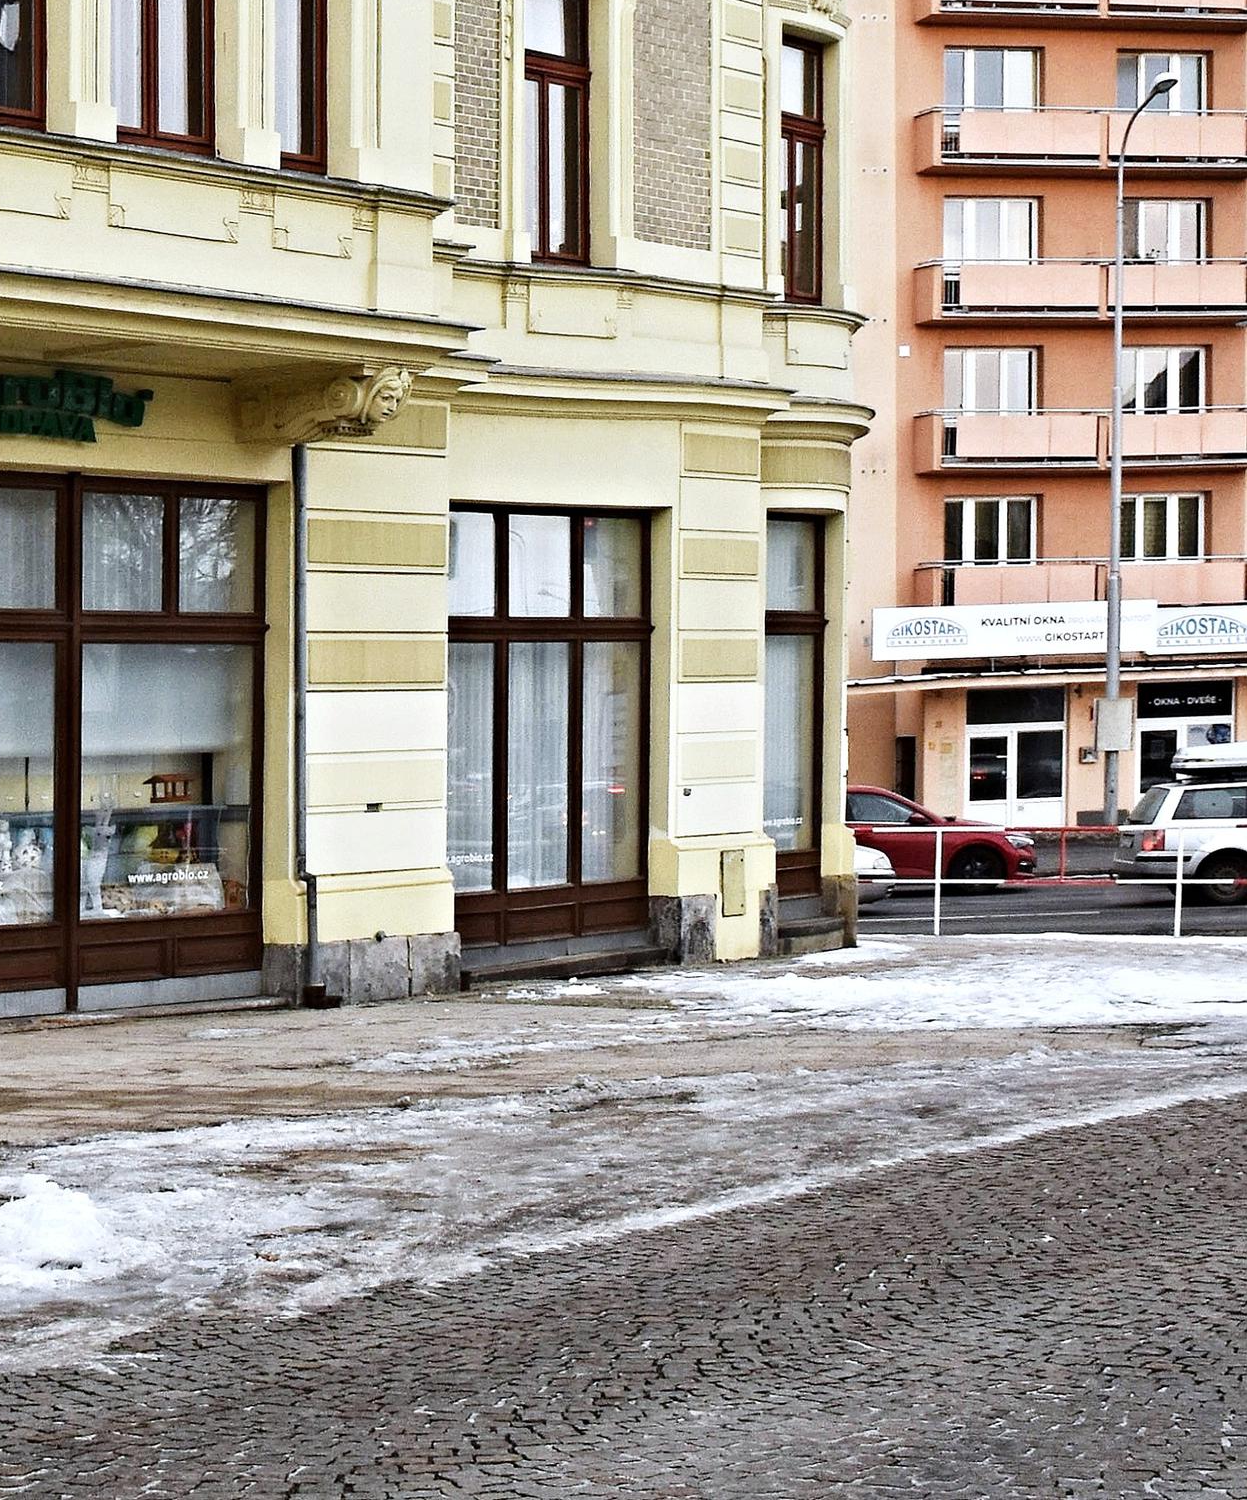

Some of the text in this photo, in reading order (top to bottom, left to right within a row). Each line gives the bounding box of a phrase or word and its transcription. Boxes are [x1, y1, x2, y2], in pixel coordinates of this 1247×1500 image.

[981, 615, 1031, 627] KVALITNÍ
[1034, 616, 1066, 625] OKNA
[892, 620, 961, 636] GIKOSTART
[1153, 697, 1180, 706] OKNA
[128, 869, 209, 884] www.agrobio.cz
